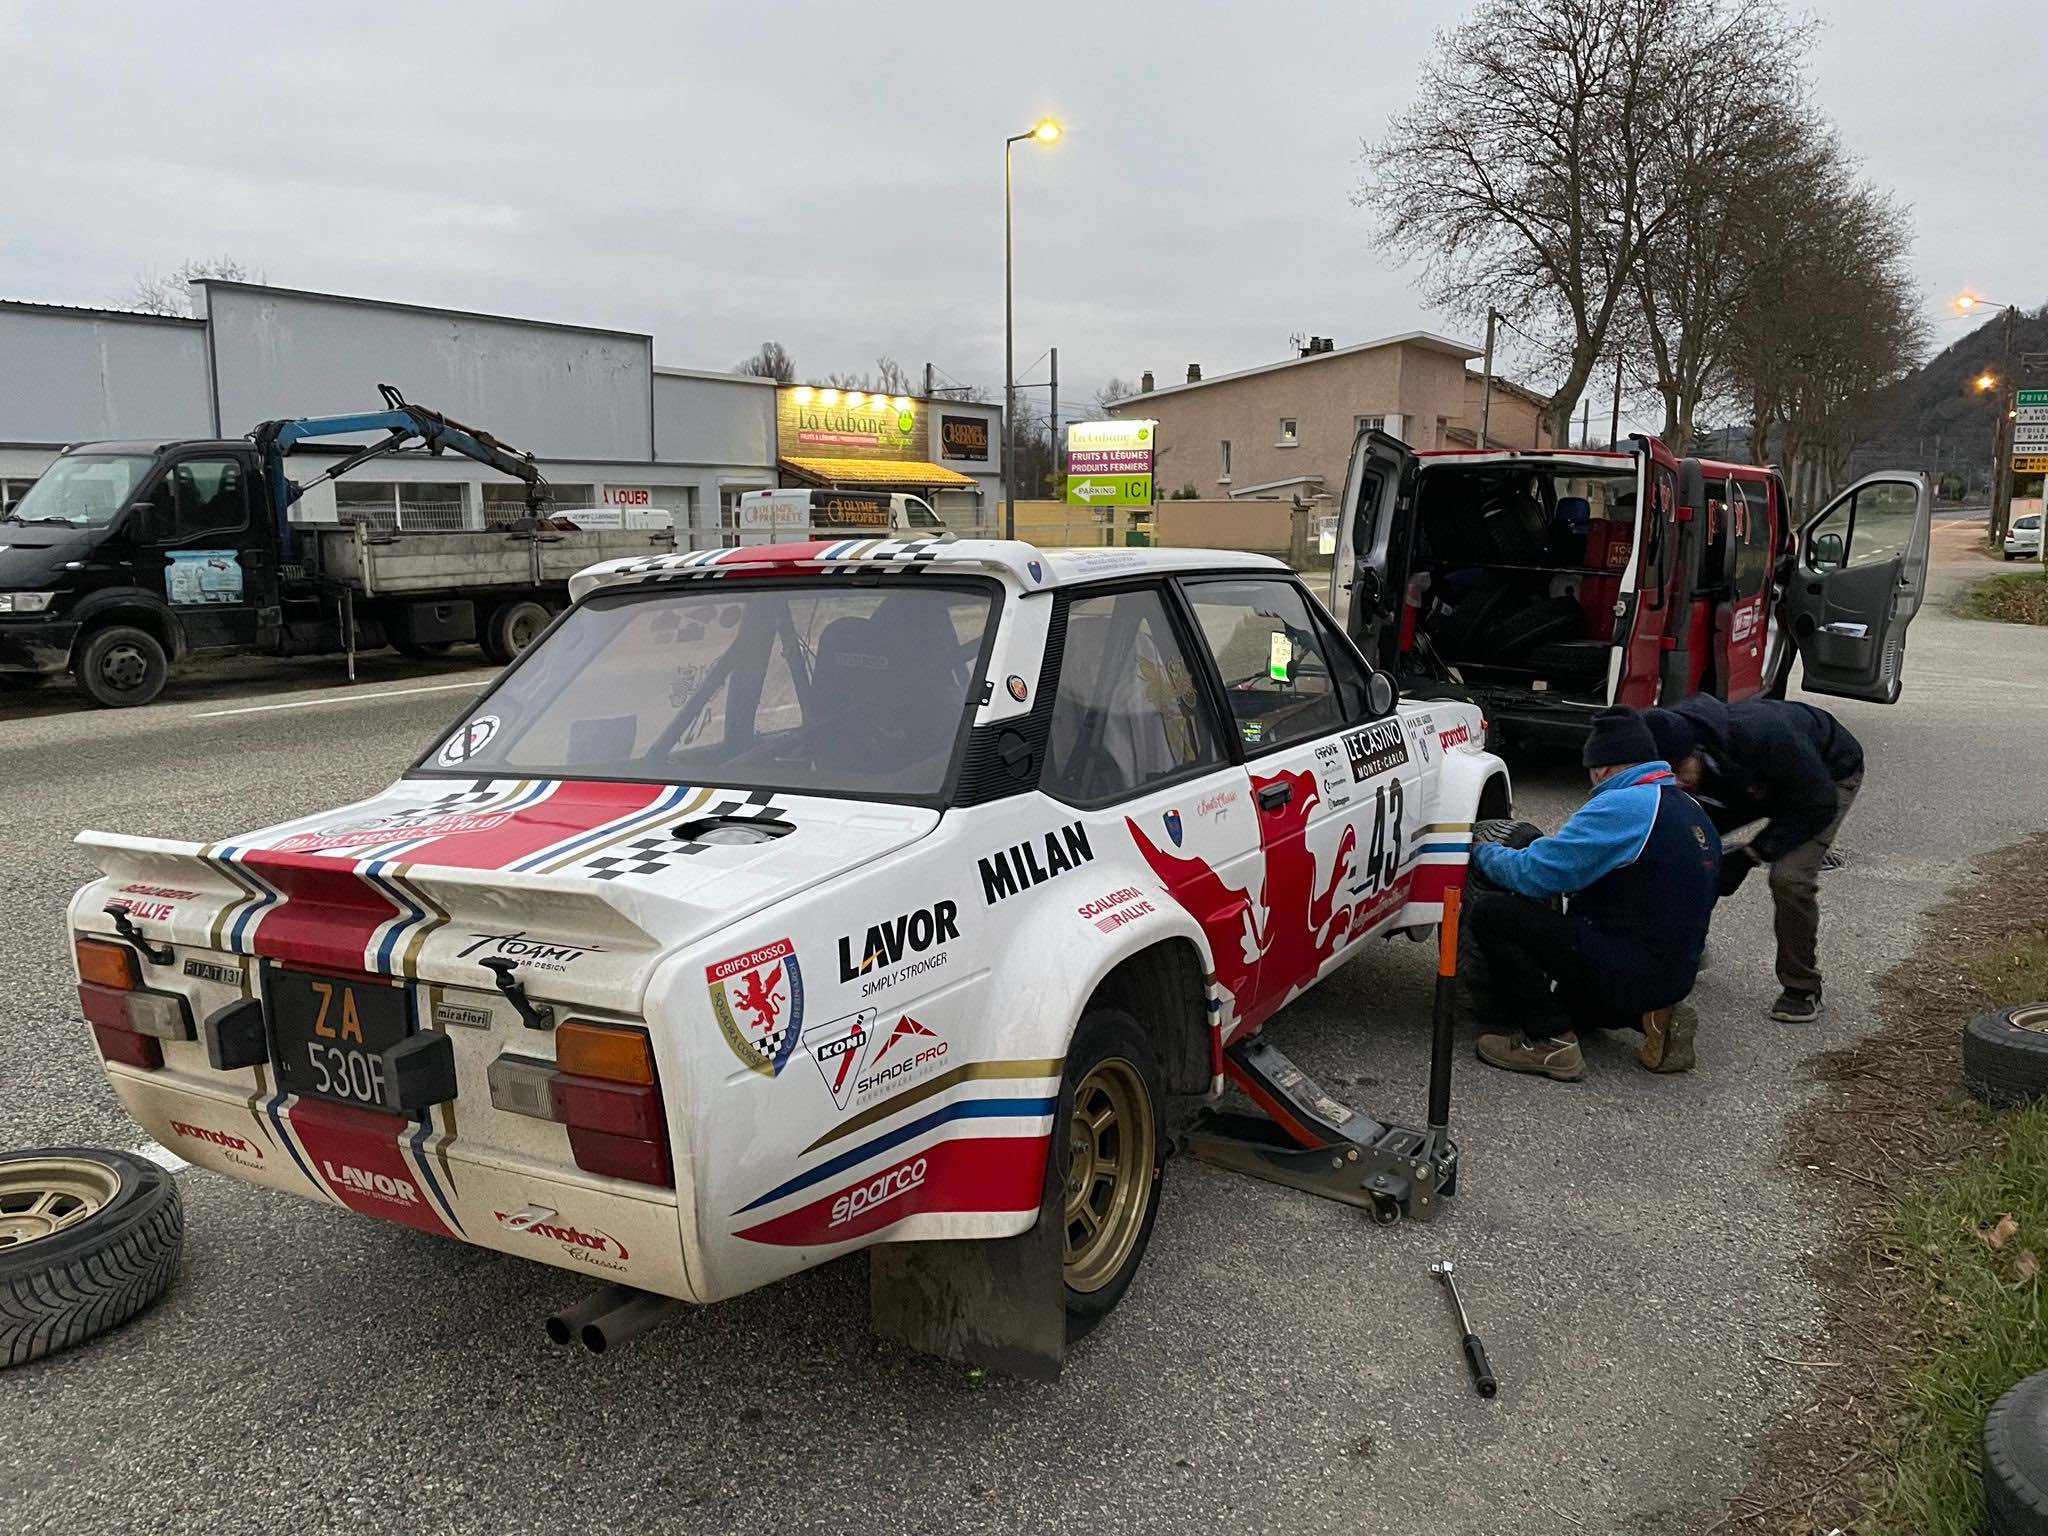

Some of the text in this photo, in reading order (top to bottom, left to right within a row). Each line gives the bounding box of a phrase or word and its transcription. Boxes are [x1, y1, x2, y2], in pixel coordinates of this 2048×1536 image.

[799, 406, 887, 433] La Cabane
[1071, 462, 1149, 472] PRODUITS FERMIERS
[1072, 450, 1149, 461] FRUITS & LÉGUMES
[613, 490, 649, 505] LOUER
[1125, 481, 1147, 498] ICI
[842, 499, 880, 512] OLYMPE
[1344, 721, 1402, 762] LE CASINO
[1367, 777, 1403, 895] 43
[977, 820, 1094, 905] MILAN
[1078, 886, 1144, 919] SCALIGERA
[1111, 901, 1155, 926] RALLYE
[456, 931, 605, 962] ADAMI
[838, 900, 960, 984] LAVOR
[185, 963, 240, 985] FIAT 131
[534, 961, 567, 973] DESIGN
[715, 943, 786, 978] GRIFO ROSSO
[862, 952, 948, 998] SIMPLY STRONGER
[311, 981, 363, 1044] ZA
[437, 1009, 486, 1025] mirafiori
[715, 991, 739, 1043] SQUADRA
[821, 1033, 865, 1060] KONI
[170, 1120, 248, 1152] promotor
[323, 1160, 420, 1203] LAVOR
[831, 1158, 927, 1224] sparco
[561, 1244, 628, 1273] Classic
